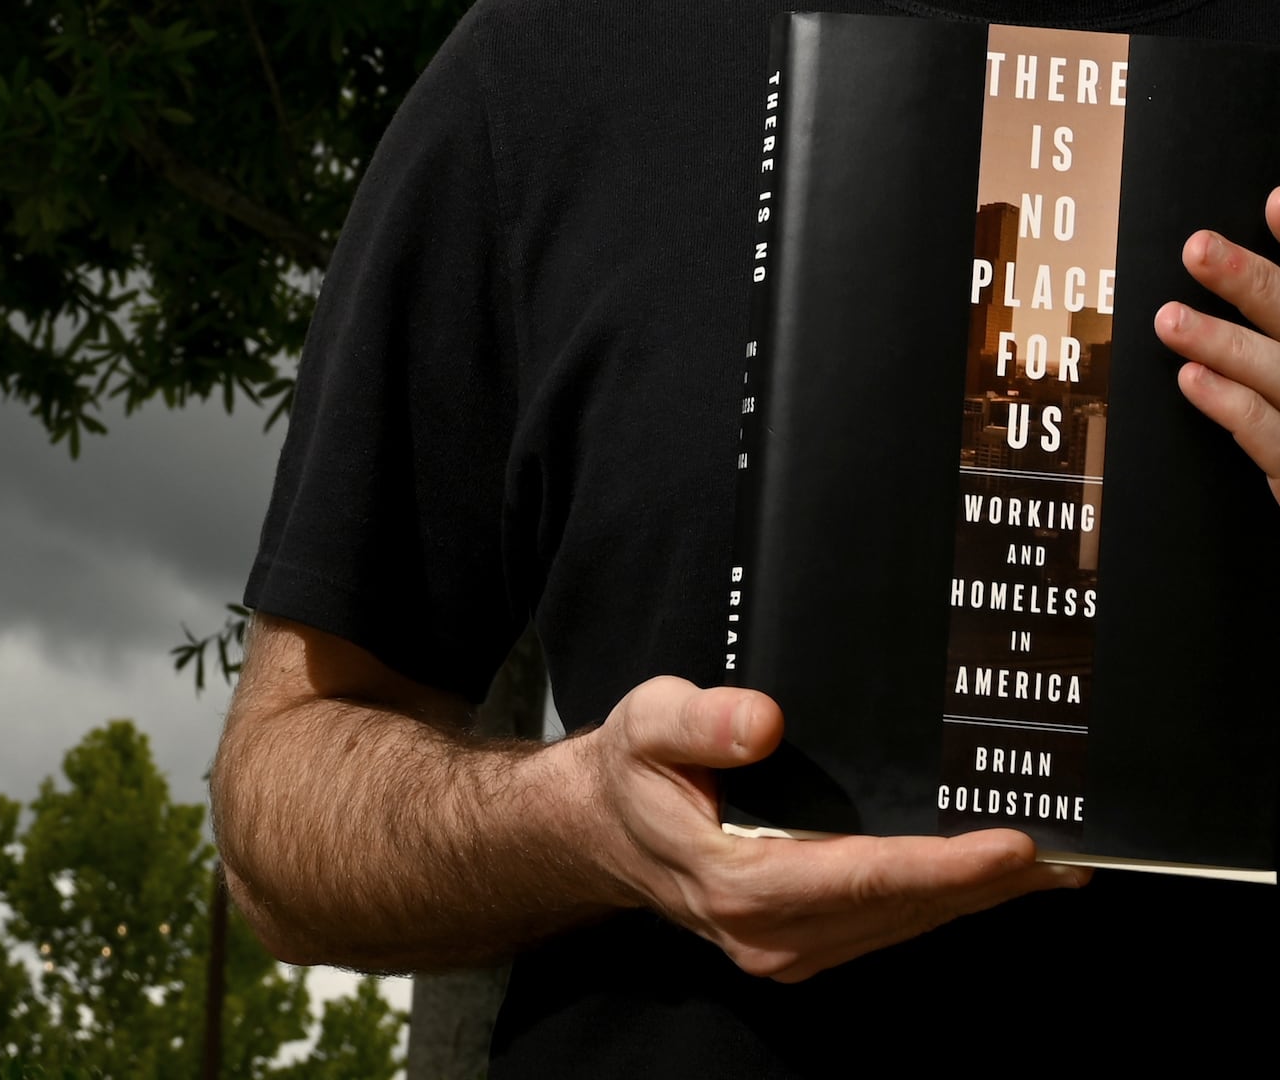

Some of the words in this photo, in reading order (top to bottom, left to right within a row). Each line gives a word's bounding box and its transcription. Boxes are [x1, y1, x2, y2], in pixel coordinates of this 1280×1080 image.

[986, 51, 1128, 106] THERE
[761, 70, 780, 173] THERE
[1031, 125, 1074, 171] IS
[757, 191, 772, 223] IS
[1019, 193, 1075, 241] NO
[753, 242, 768, 283] NO
[970, 258, 1116, 314] PLACE
[997, 332, 1080, 382] FOR
[1007, 402, 1062, 452] US
[964, 494, 1095, 533] WORKING
[1006, 543, 1046, 567] AND
[725, 566, 743, 670] BRIAN
[950, 578, 1097, 618] HOMELESS
[1011, 630, 1031, 652] IN
[955, 666, 1081, 704] AMERICA
[975, 746, 1052, 777] BRIAN
[937, 784, 1084, 822] GOLDSTONE
